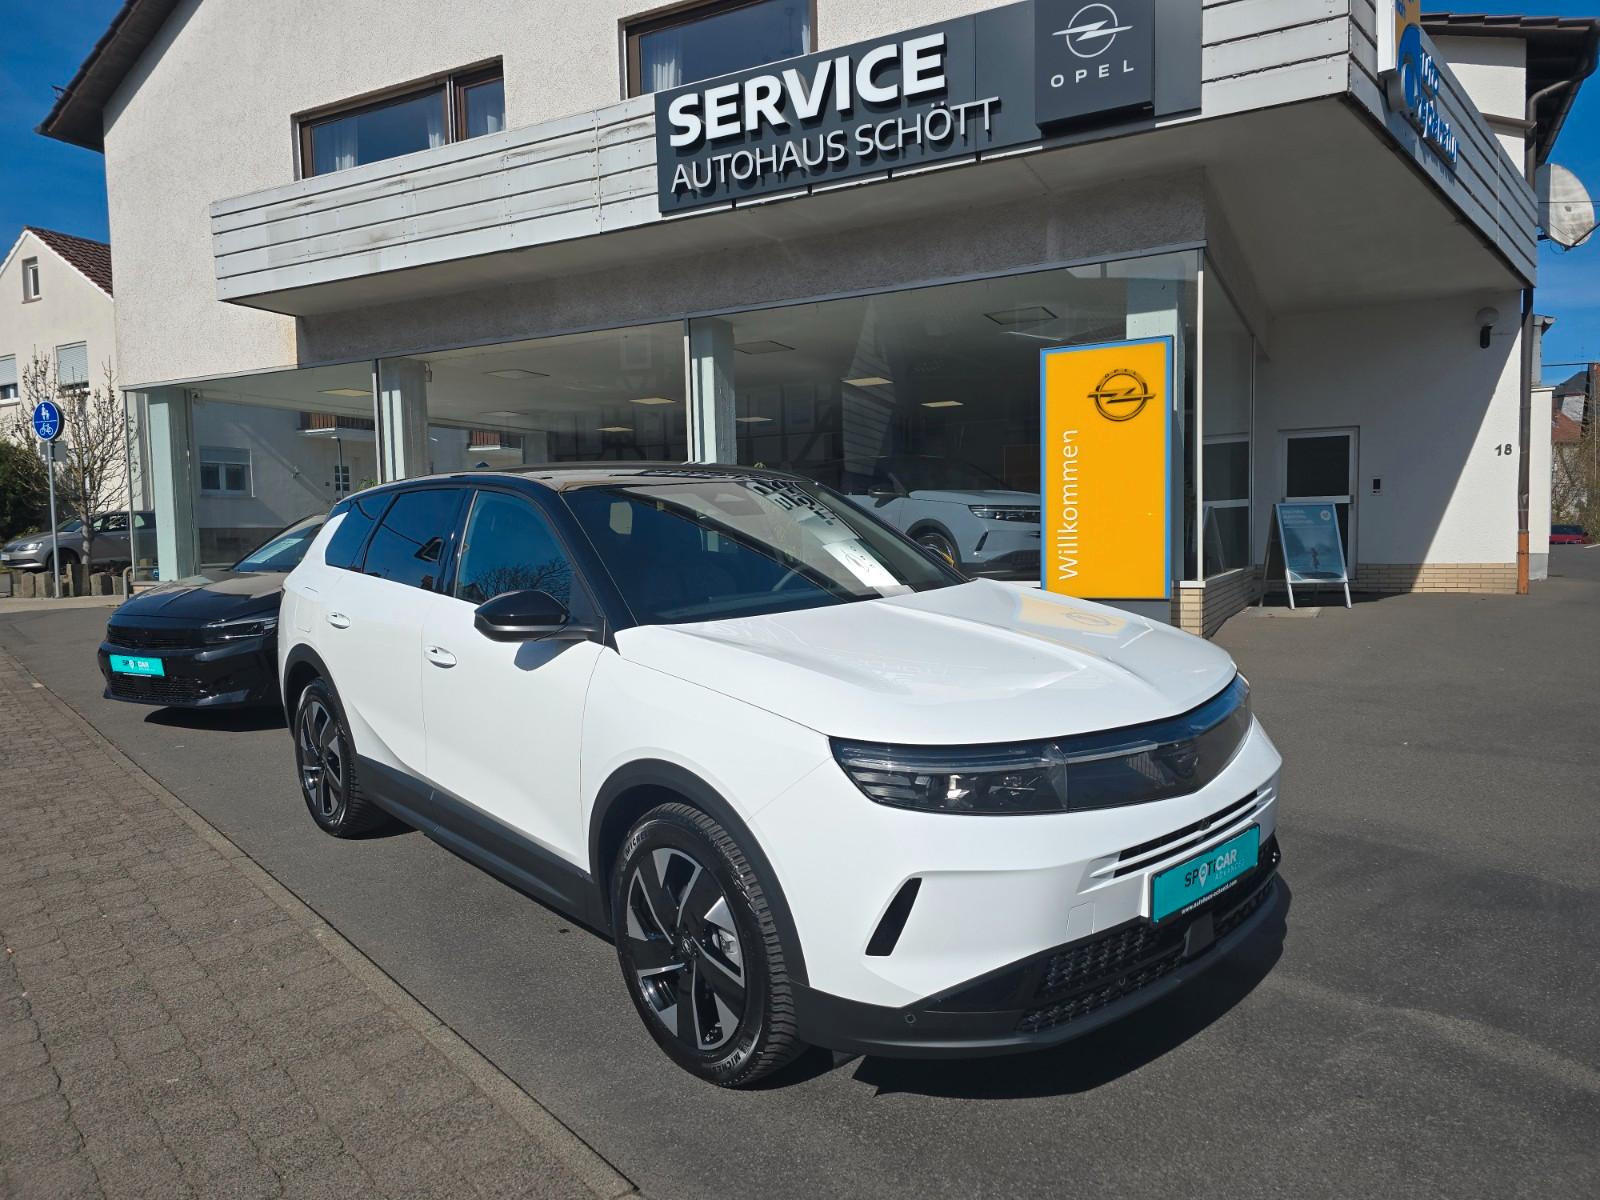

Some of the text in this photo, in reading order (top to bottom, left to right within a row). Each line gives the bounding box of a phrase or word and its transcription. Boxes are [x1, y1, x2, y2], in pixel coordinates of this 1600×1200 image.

[668, 32, 948, 148] SERVICE
[1050, 59, 1135, 89] OPEL
[670, 95, 1001, 195] AUTOHAUS SCHÖTT
[1494, 443, 1513, 457] 18
[1056, 429, 1079, 581] Willkommen
